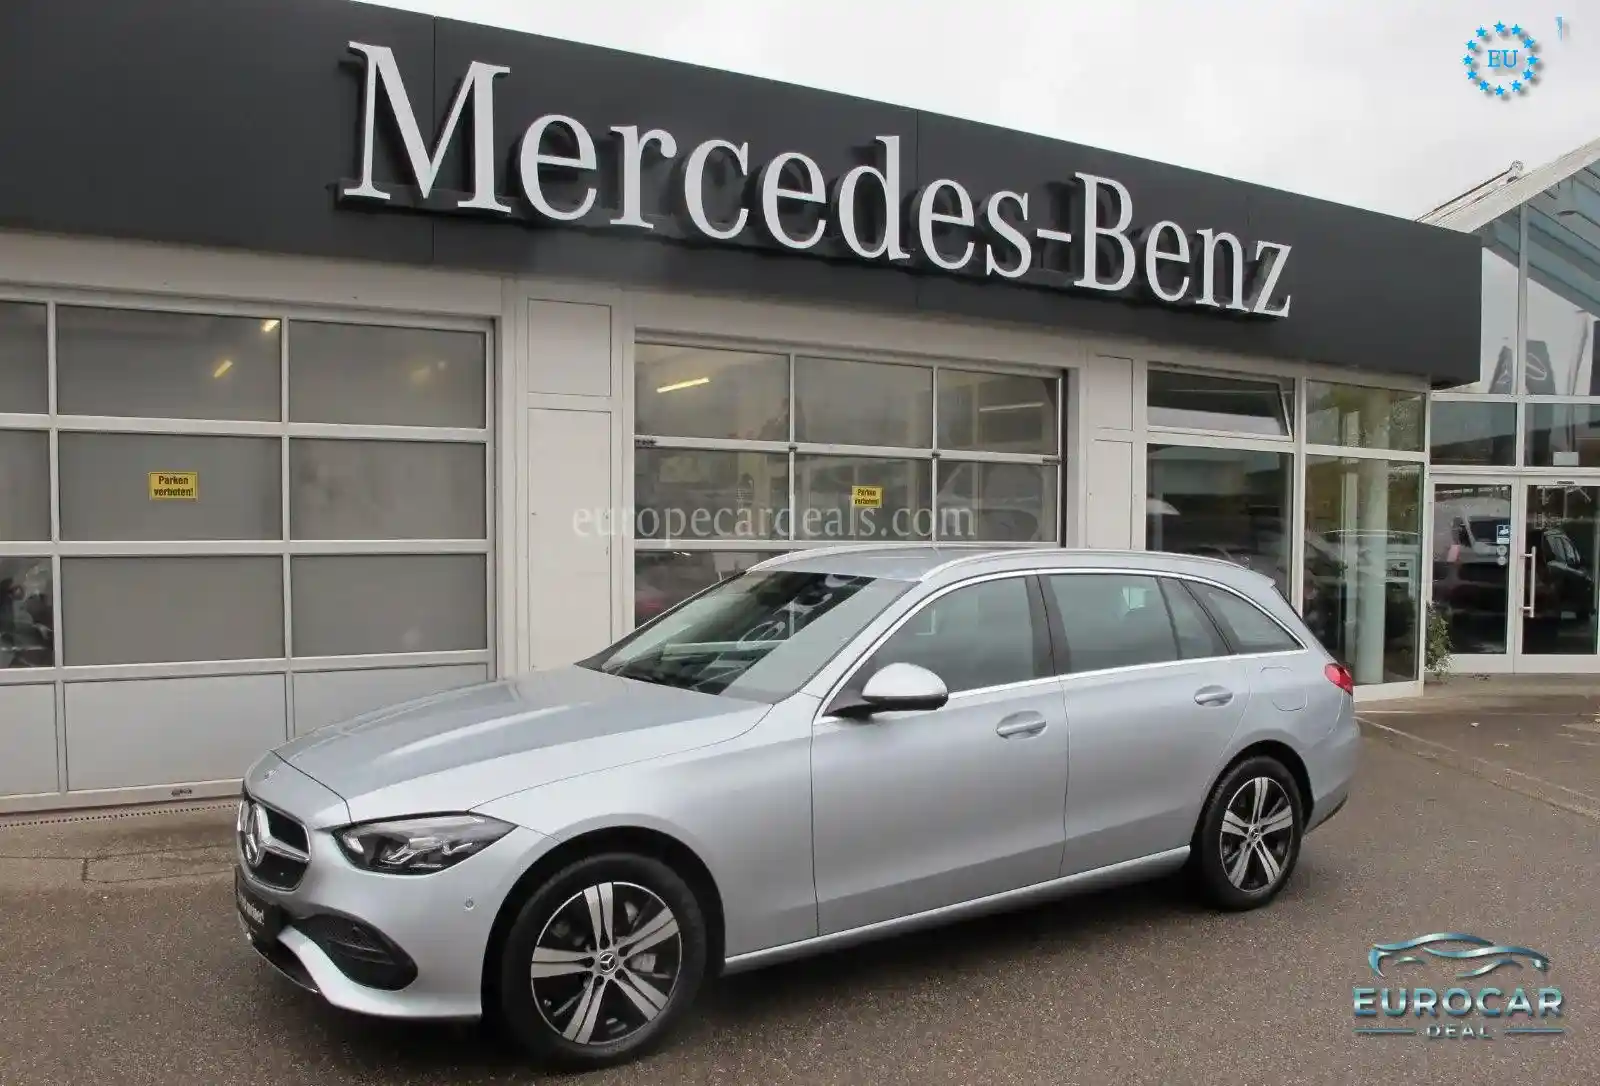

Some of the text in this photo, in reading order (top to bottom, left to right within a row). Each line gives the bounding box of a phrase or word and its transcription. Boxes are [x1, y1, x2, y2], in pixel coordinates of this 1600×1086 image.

[343, 41, 1292, 318] Mercedes-Benz
[158, 475, 189, 485] Parken
[153, 487, 194, 497] verboten!
